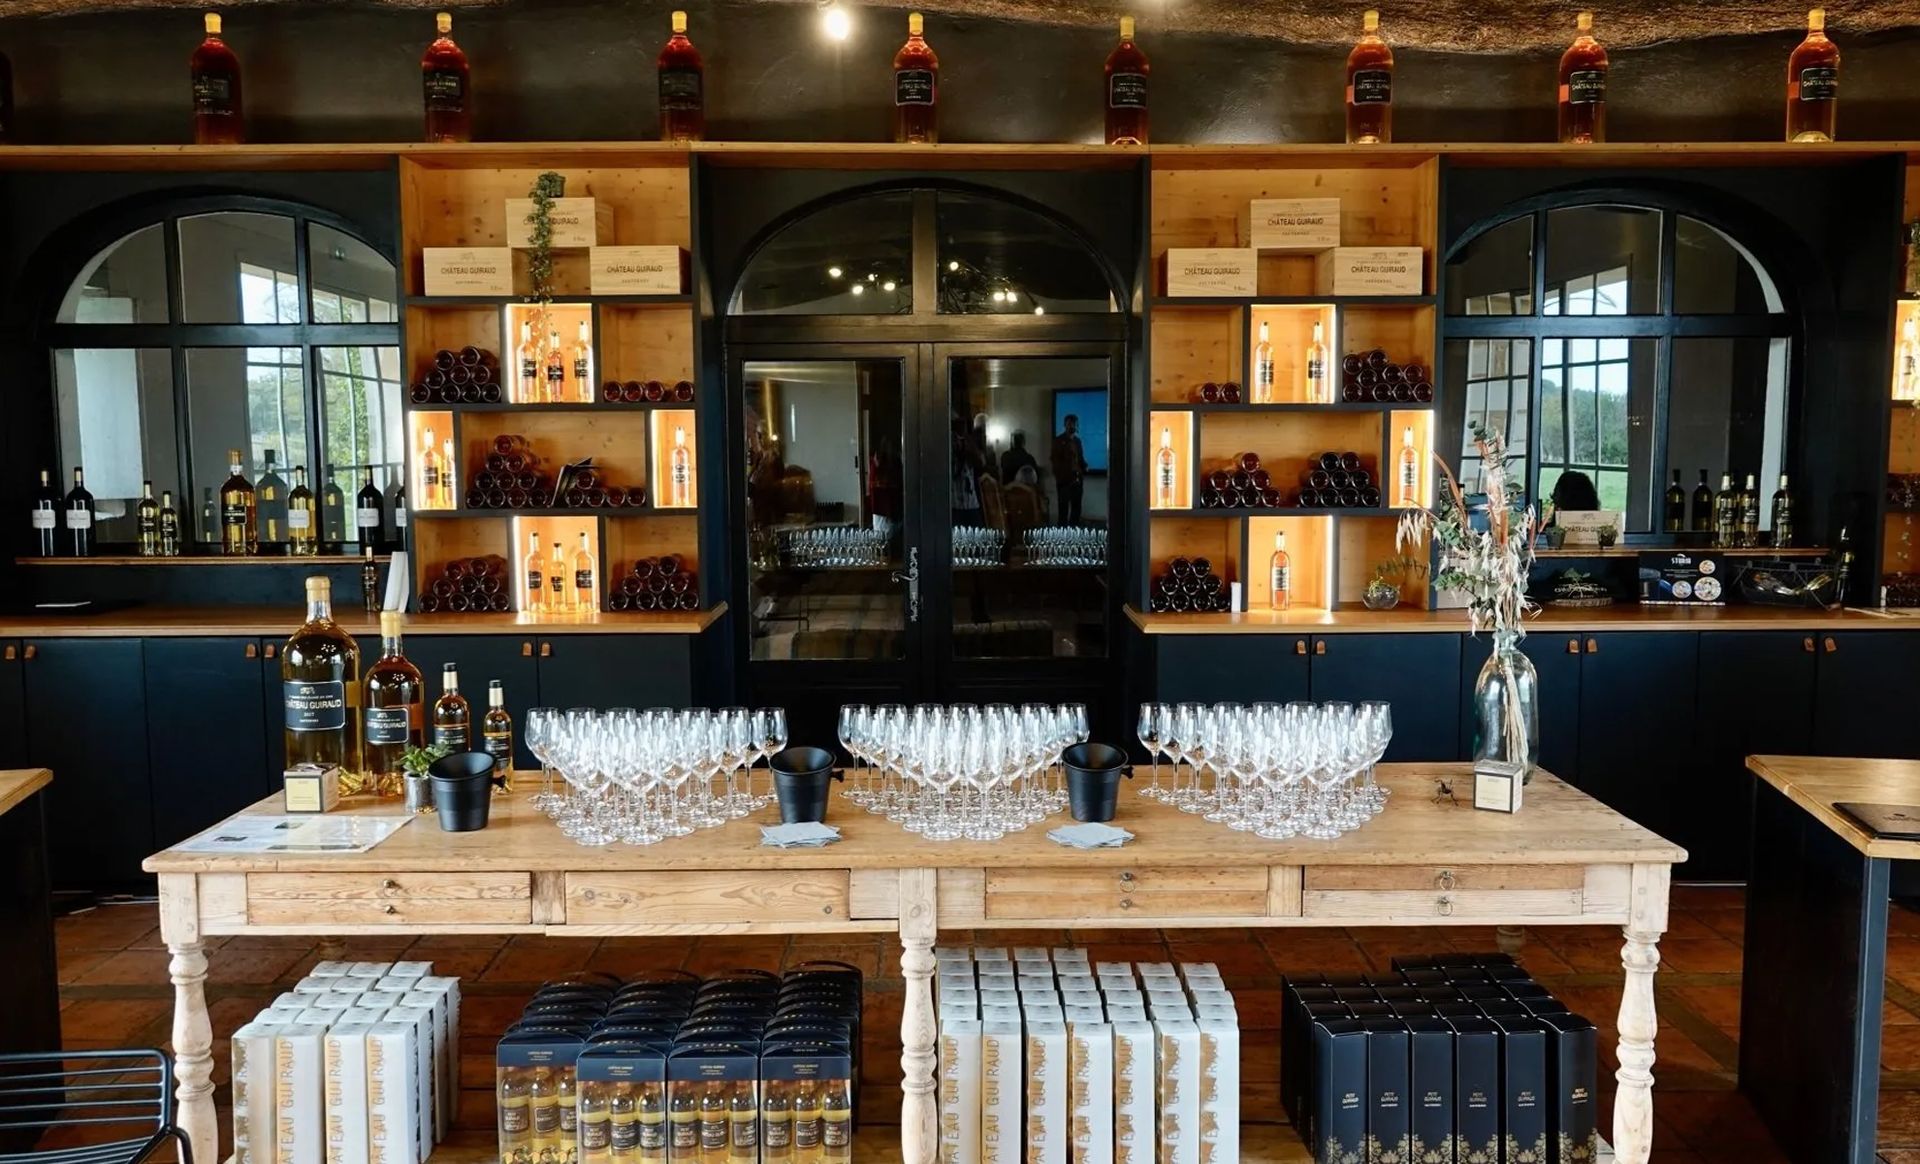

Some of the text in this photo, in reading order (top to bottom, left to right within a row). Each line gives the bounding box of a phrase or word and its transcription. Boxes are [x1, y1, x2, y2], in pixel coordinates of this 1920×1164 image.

[1213, 267, 1240, 275] GUIRAUD
[1297, 217, 1324, 225] GUIRAUD
[310, 699, 342, 709] GUIRAUD
[278, 1040, 295, 1164] ÂTEAU GUIRAUD
[329, 1040, 344, 1164] ÂTEAU GUIRAUD
[371, 1039, 386, 1164] ÂTEAU GUIRAUD
[946, 1039, 959, 1164] ÂTEAU GUIRAUD
[984, 1039, 999, 1163] ÂTEAU GUIRAUD
[1031, 1039, 1046, 1164] ÂTEAU GUIRAUD
